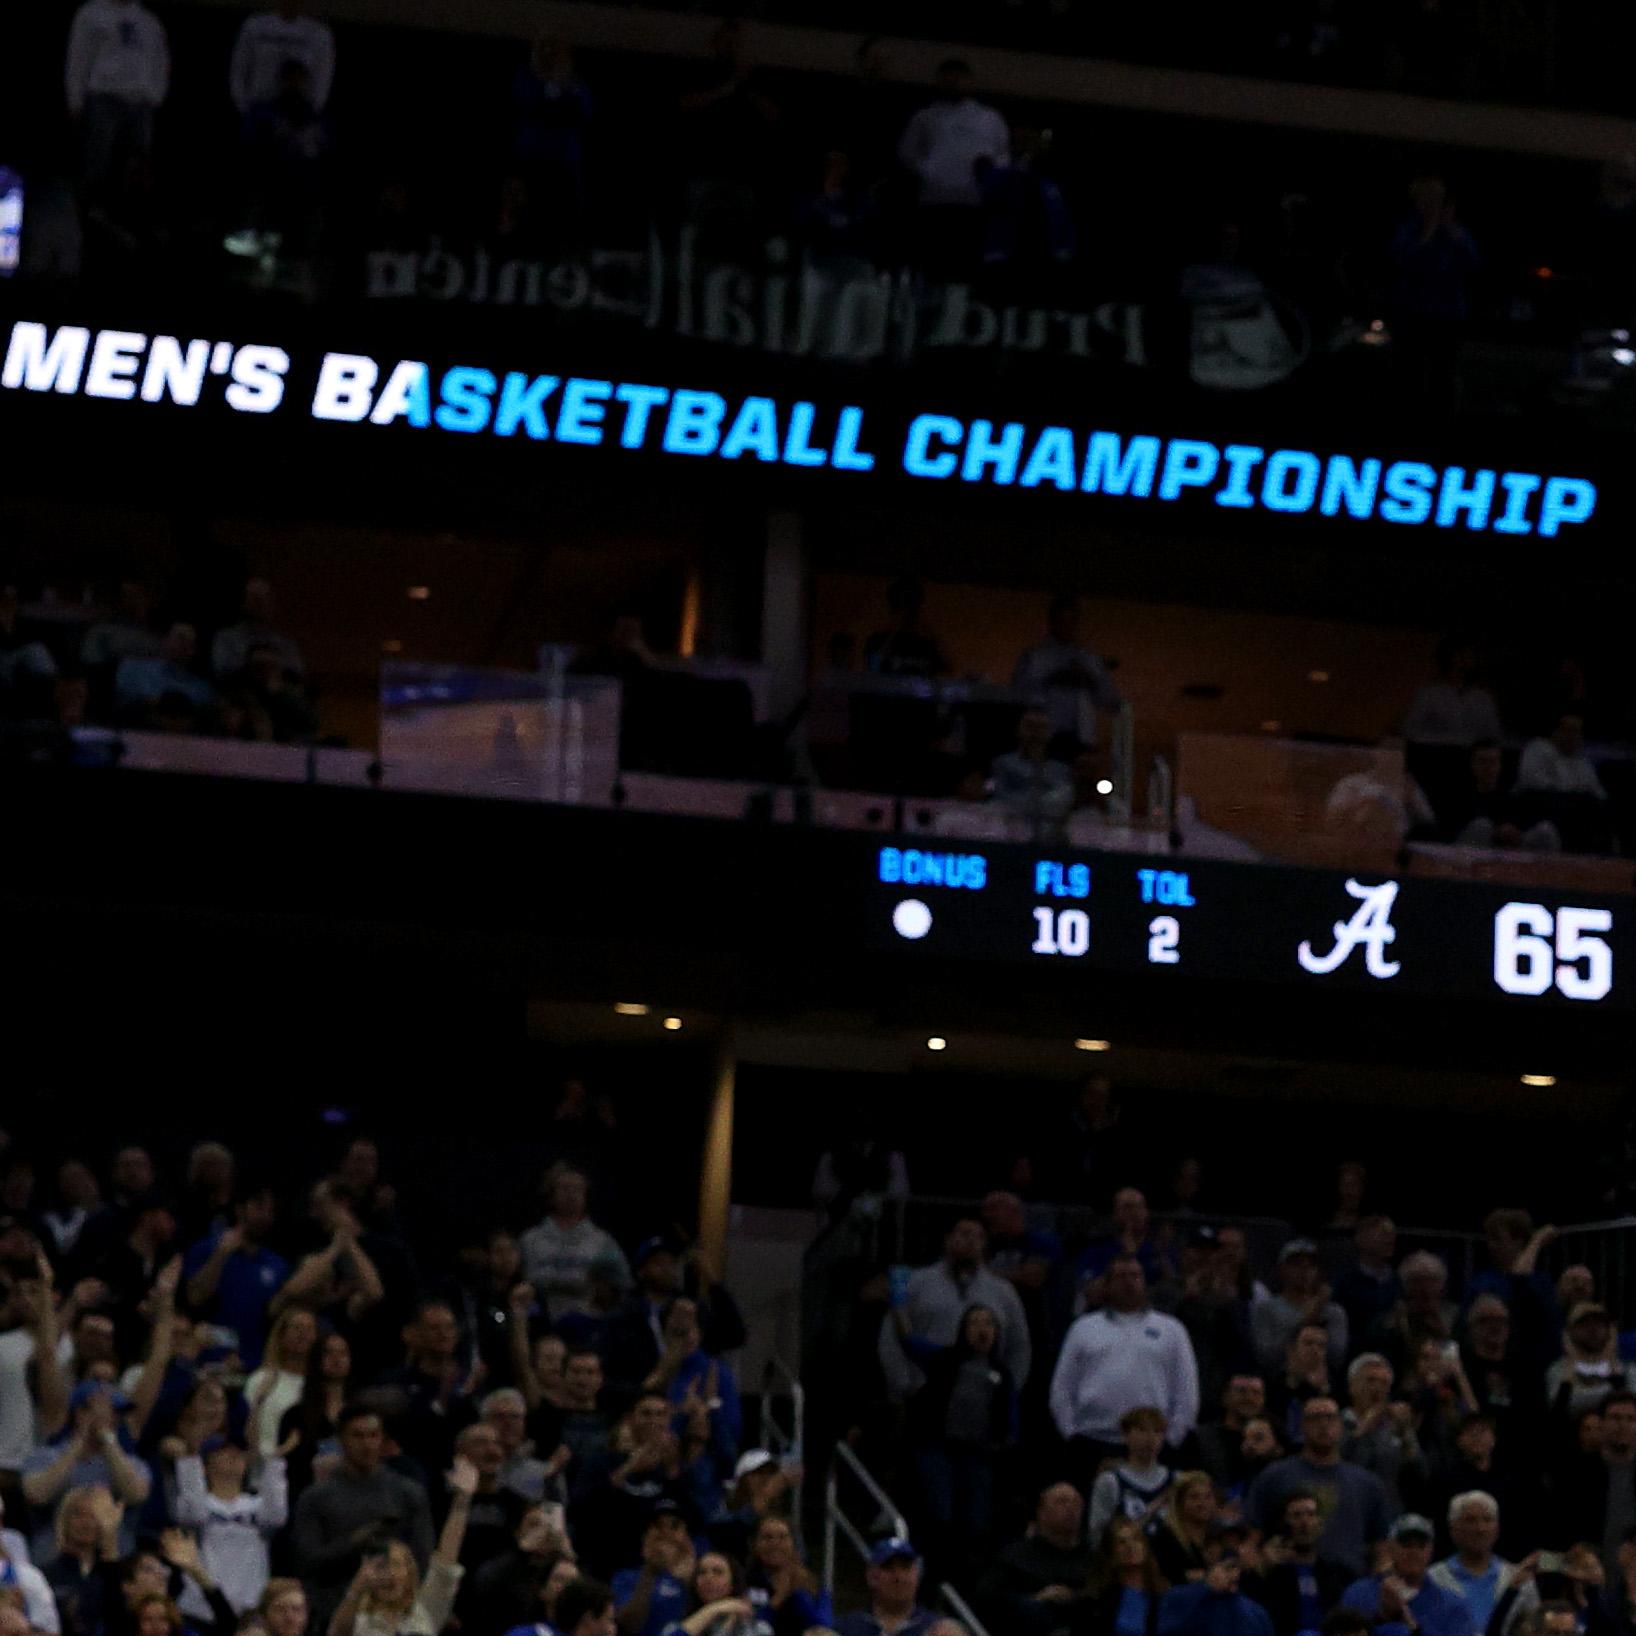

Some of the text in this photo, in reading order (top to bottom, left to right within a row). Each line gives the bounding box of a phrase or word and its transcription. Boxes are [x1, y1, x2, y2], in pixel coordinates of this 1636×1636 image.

[2, 321, 1598, 538] MEN'S BASKETBALL CHAMPIONSHIP
[878, 846, 1196, 907] BONUS FLS TOL
[1031, 906, 1181, 964] 10 2
[1297, 878, 1401, 979] A
[1493, 901, 1613, 1001] 65
